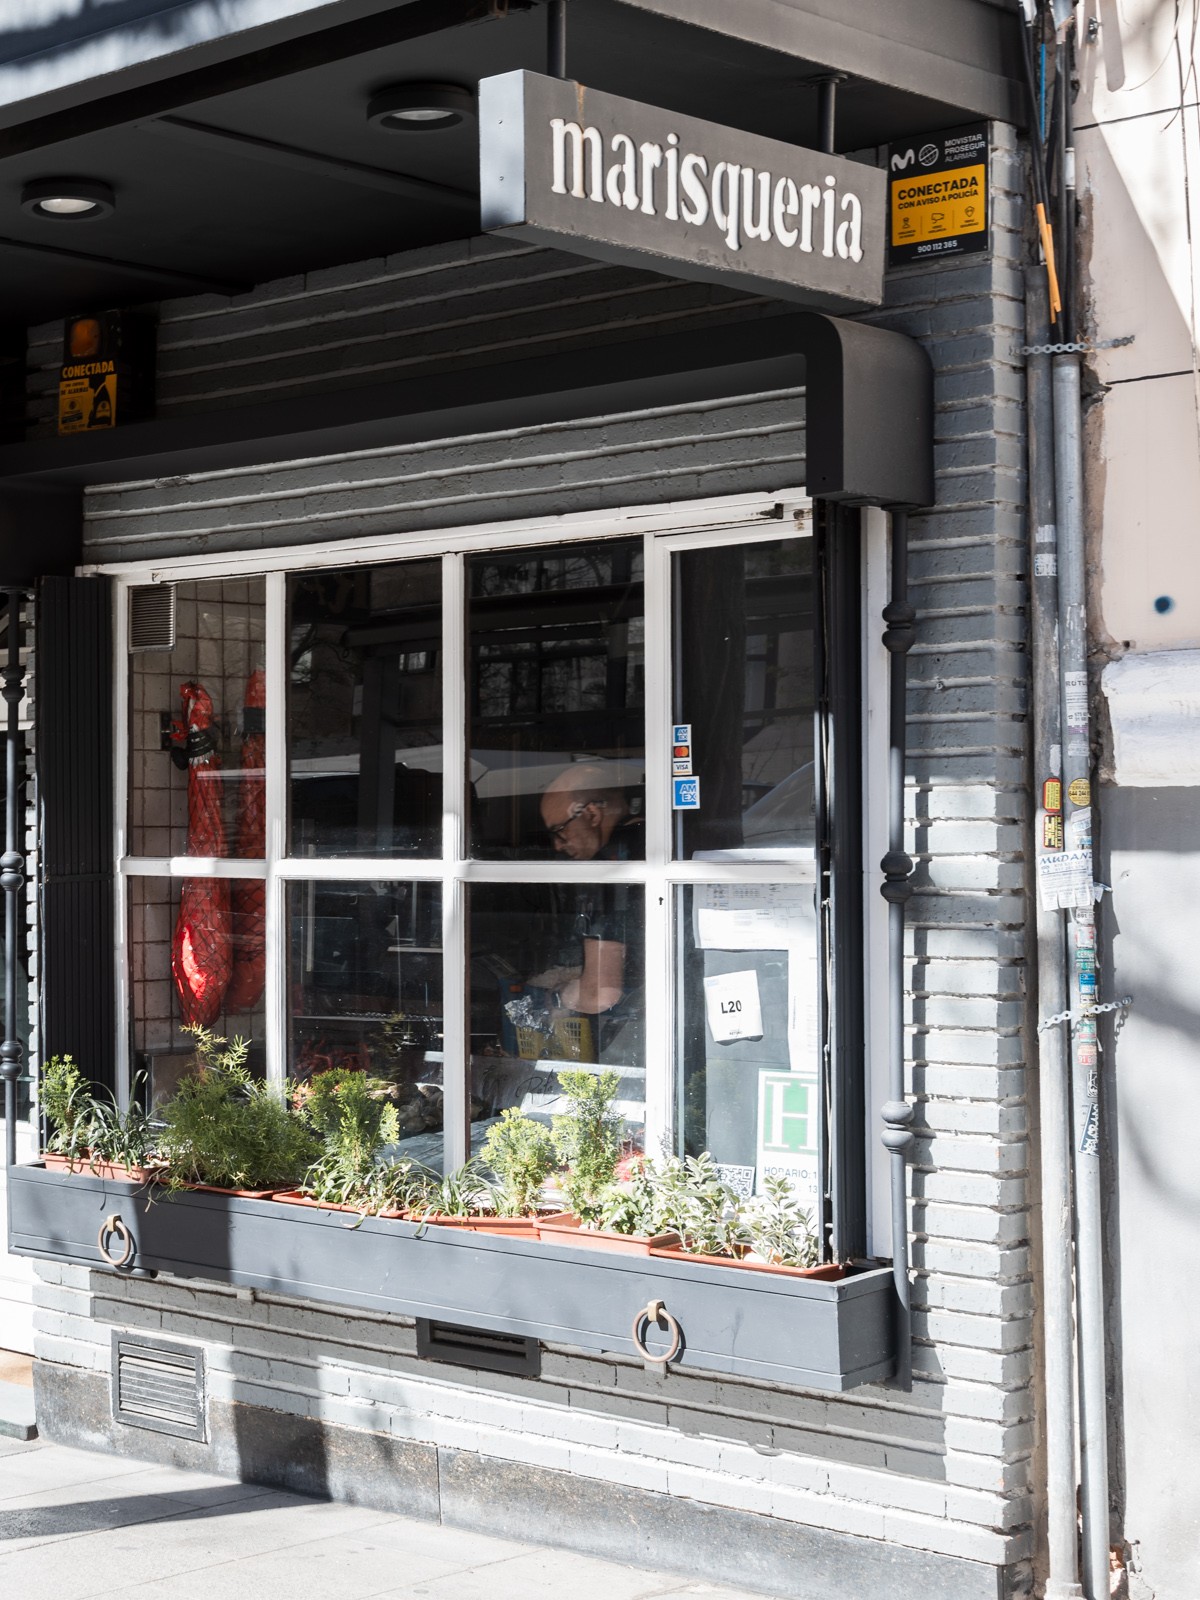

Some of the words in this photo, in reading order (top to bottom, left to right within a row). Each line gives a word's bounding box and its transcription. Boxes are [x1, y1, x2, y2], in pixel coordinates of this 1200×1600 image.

[944, 133, 983, 147] MOVISTAR
[944, 141, 986, 155] PROSEGUR
[944, 150, 978, 163] ALARMAS
[550, 118, 865, 263] marisqueria
[898, 176, 978, 200] CONECTADA
[898, 202, 915, 210] CON
[916, 196, 940, 207] AVISO
[948, 189, 978, 201] POLICÍA
[917, 244, 932, 253] 900
[932, 242, 942, 251] 112
[62, 360, 114, 378] CONECTADA
[680, 783, 697, 793] AM
[683, 793, 697, 801] EX
[721, 1000, 742, 1014] L20
[765, 1081, 818, 1150] H
